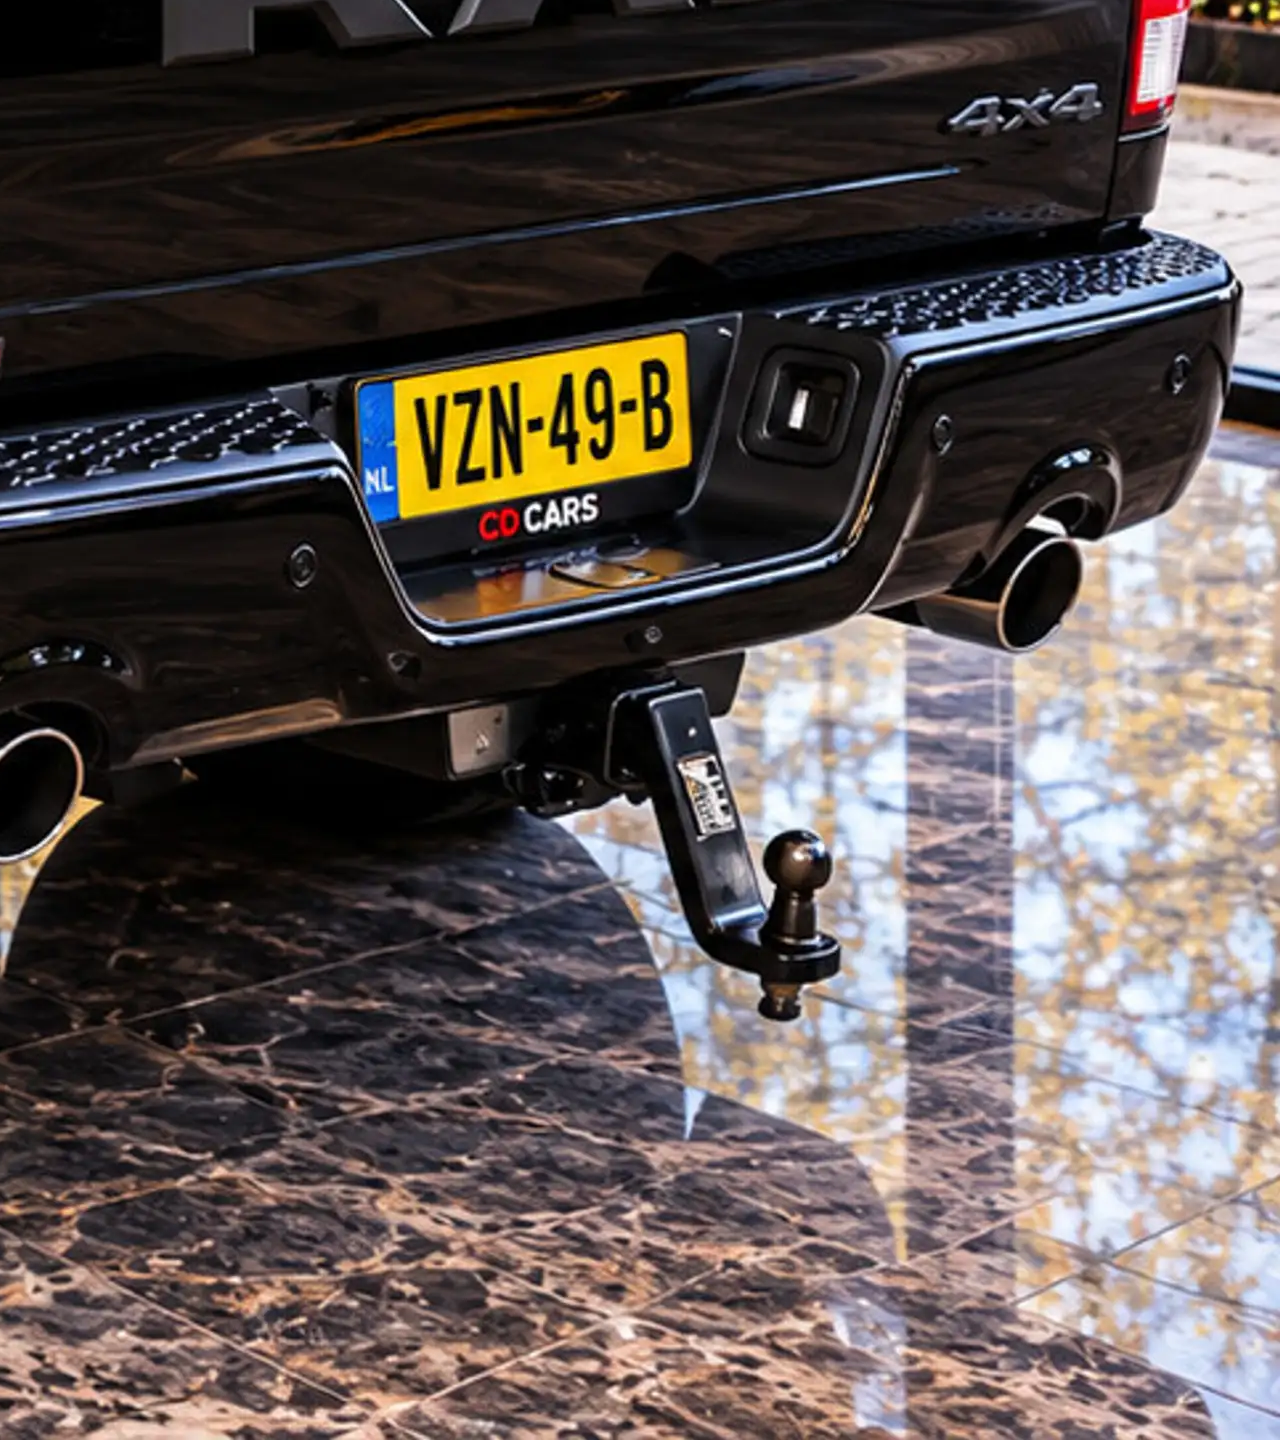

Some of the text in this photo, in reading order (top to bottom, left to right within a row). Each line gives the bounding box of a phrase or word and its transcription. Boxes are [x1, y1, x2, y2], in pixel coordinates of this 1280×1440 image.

[414, 358, 673, 491] VZN-49-B
[364, 466, 395, 496] NL
[478, 493, 600, 541] CD CARS
